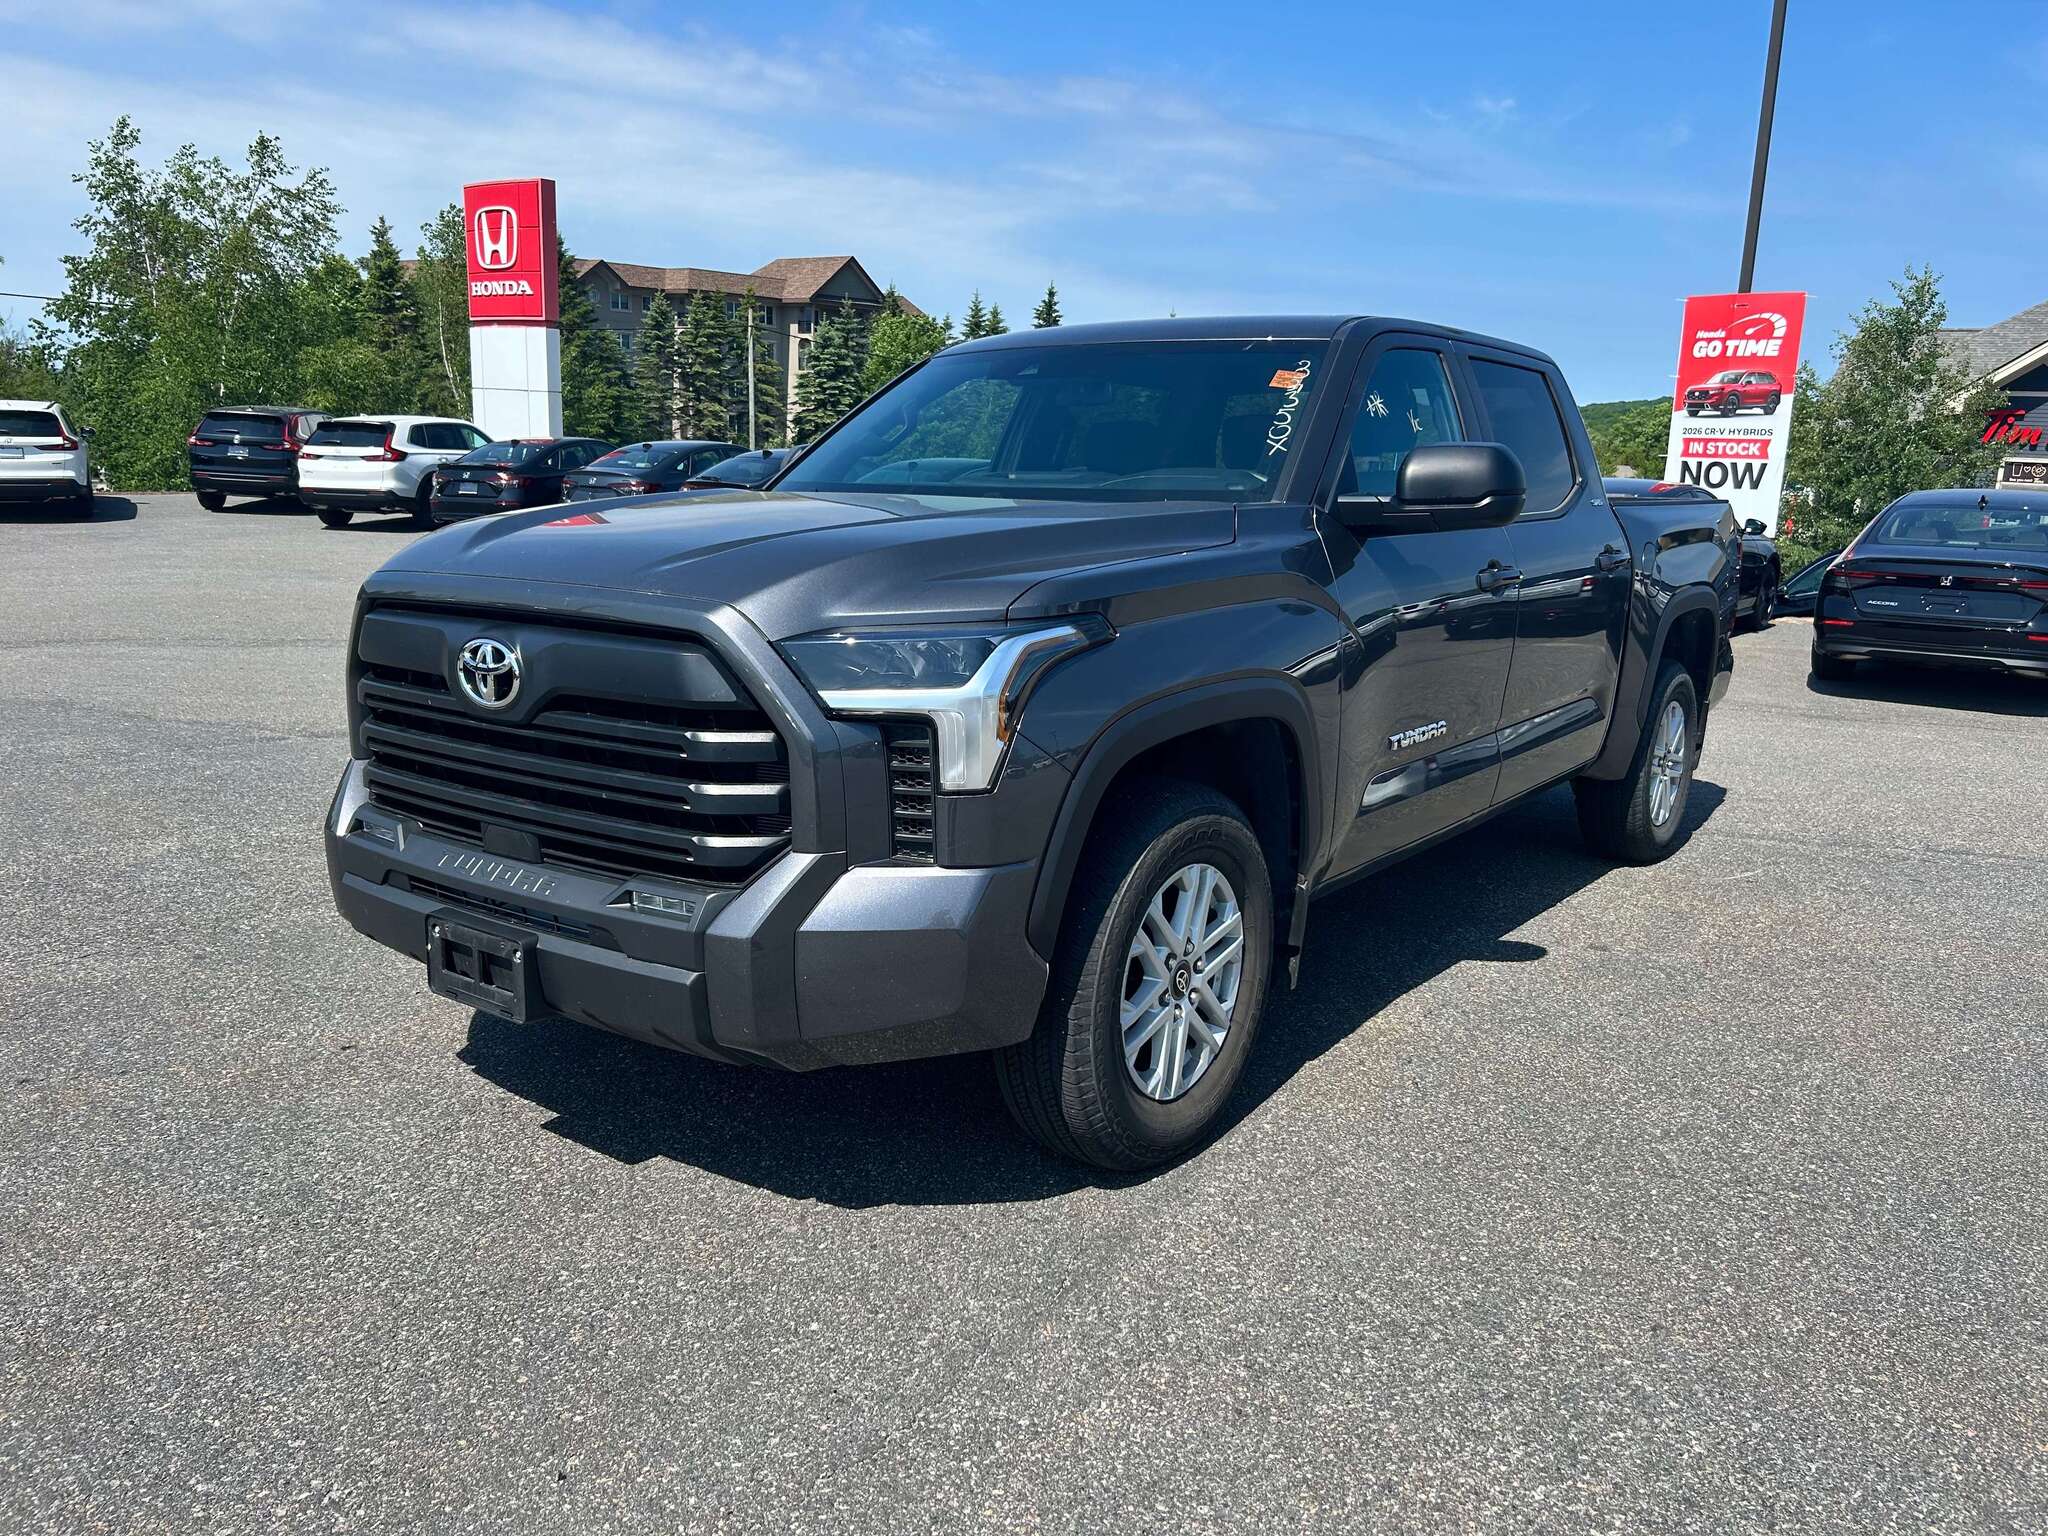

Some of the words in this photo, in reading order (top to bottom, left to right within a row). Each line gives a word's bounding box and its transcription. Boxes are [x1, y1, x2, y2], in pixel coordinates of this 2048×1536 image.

[471, 281, 534, 296] HONDA
[1696, 328, 1726, 339] Honda
[1692, 340, 1722, 358] GO
[1725, 338, 1783, 357] TIME
[1682, 427, 1703, 435] 2026
[1704, 427, 1726, 435] CR-V
[1728, 428, 1774, 436] HYBRIDS
[1688, 441, 1704, 454] IN
[1706, 441, 1761, 456] STOCK
[1680, 460, 1768, 490] NOW
[1388, 720, 1447, 751] TUNDRA
